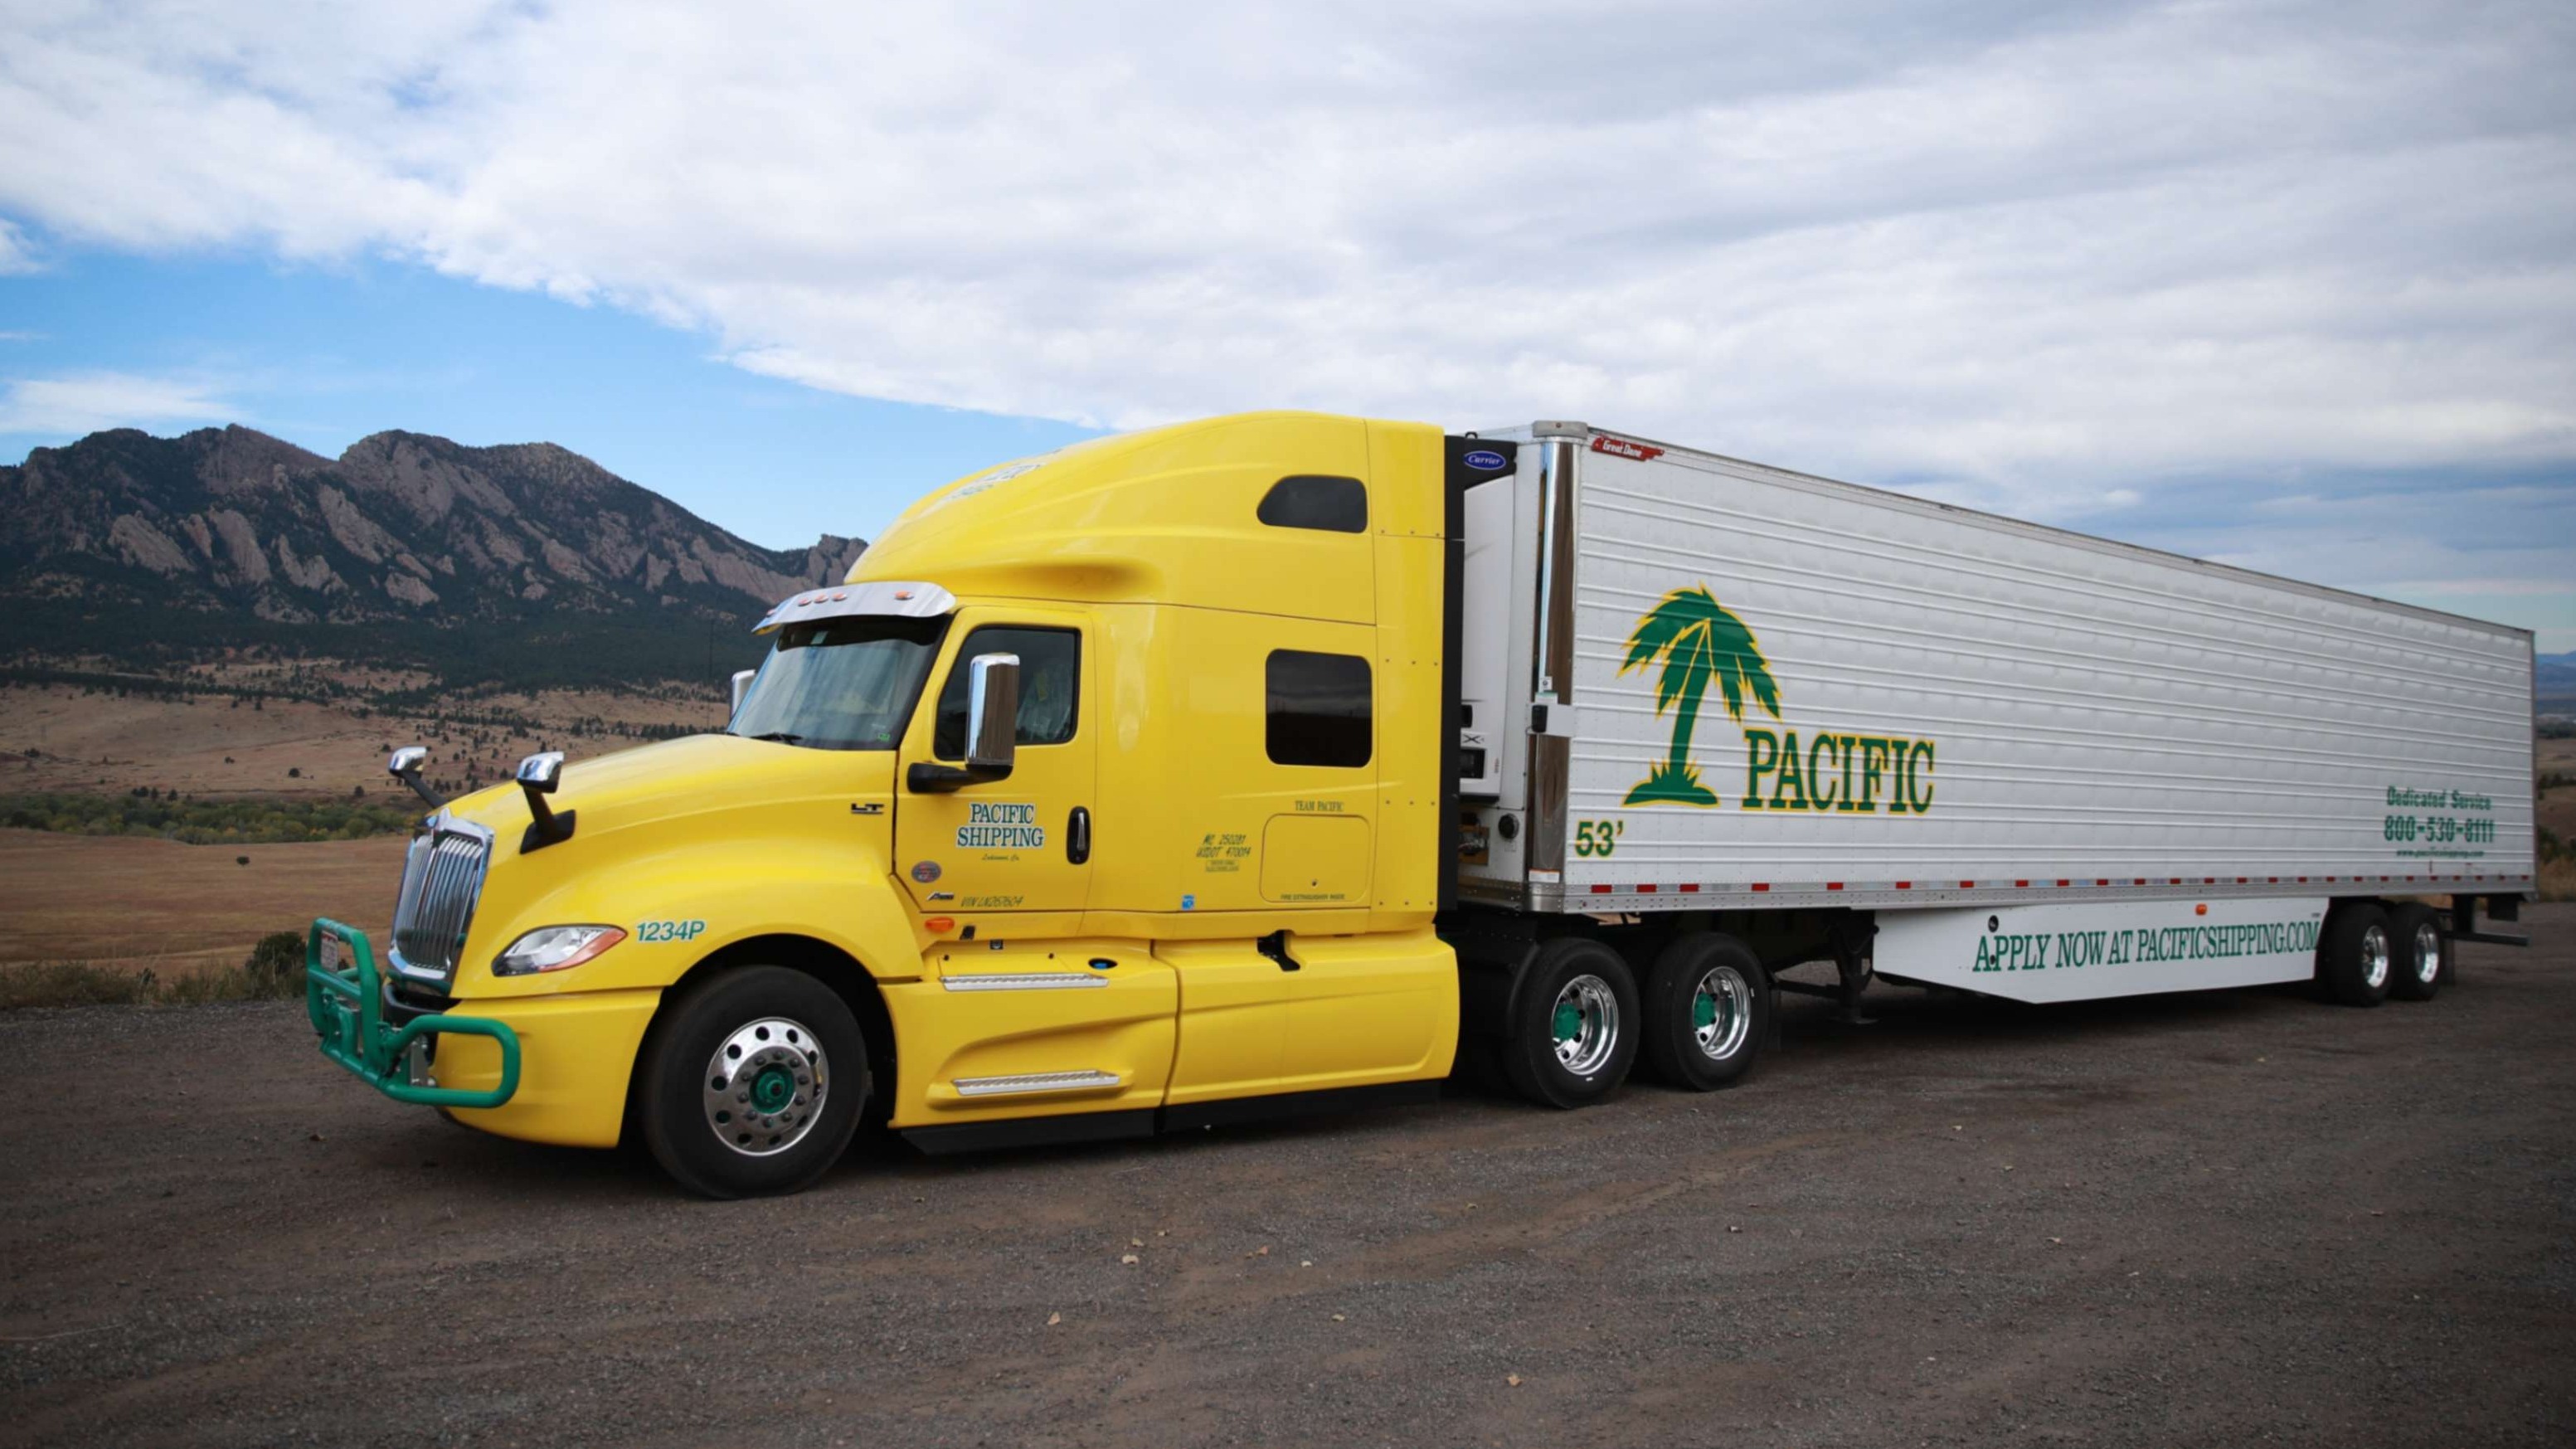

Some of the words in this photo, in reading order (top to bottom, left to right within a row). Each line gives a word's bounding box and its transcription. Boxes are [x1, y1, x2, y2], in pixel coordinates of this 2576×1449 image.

[1467, 452, 1500, 466] Carrier
[1602, 440, 1623, 454] Great
[1622, 443, 1643, 458] Dane
[1741, 727, 1935, 815] PACIFIC
[1295, 800, 1315, 811] TEAM
[1317, 801, 1343, 811] PACIFIC
[2387, 785, 2446, 808] Dedicated
[2452, 790, 2491, 810] Service
[970, 802, 1034, 824] PACIFIC
[956, 826, 1044, 848] SHIPPING
[1575, 819, 1624, 858] 53'
[2384, 815, 2494, 843] 800-530-8111
[636, 919, 706, 942] 1234P
[1972, 934, 2052, 972] APPLY
[2055, 931, 2107, 968] NOW
[2107, 929, 2134, 965] AT
[2136, 921, 2321, 962] PACIFICSHIPPING.COM
